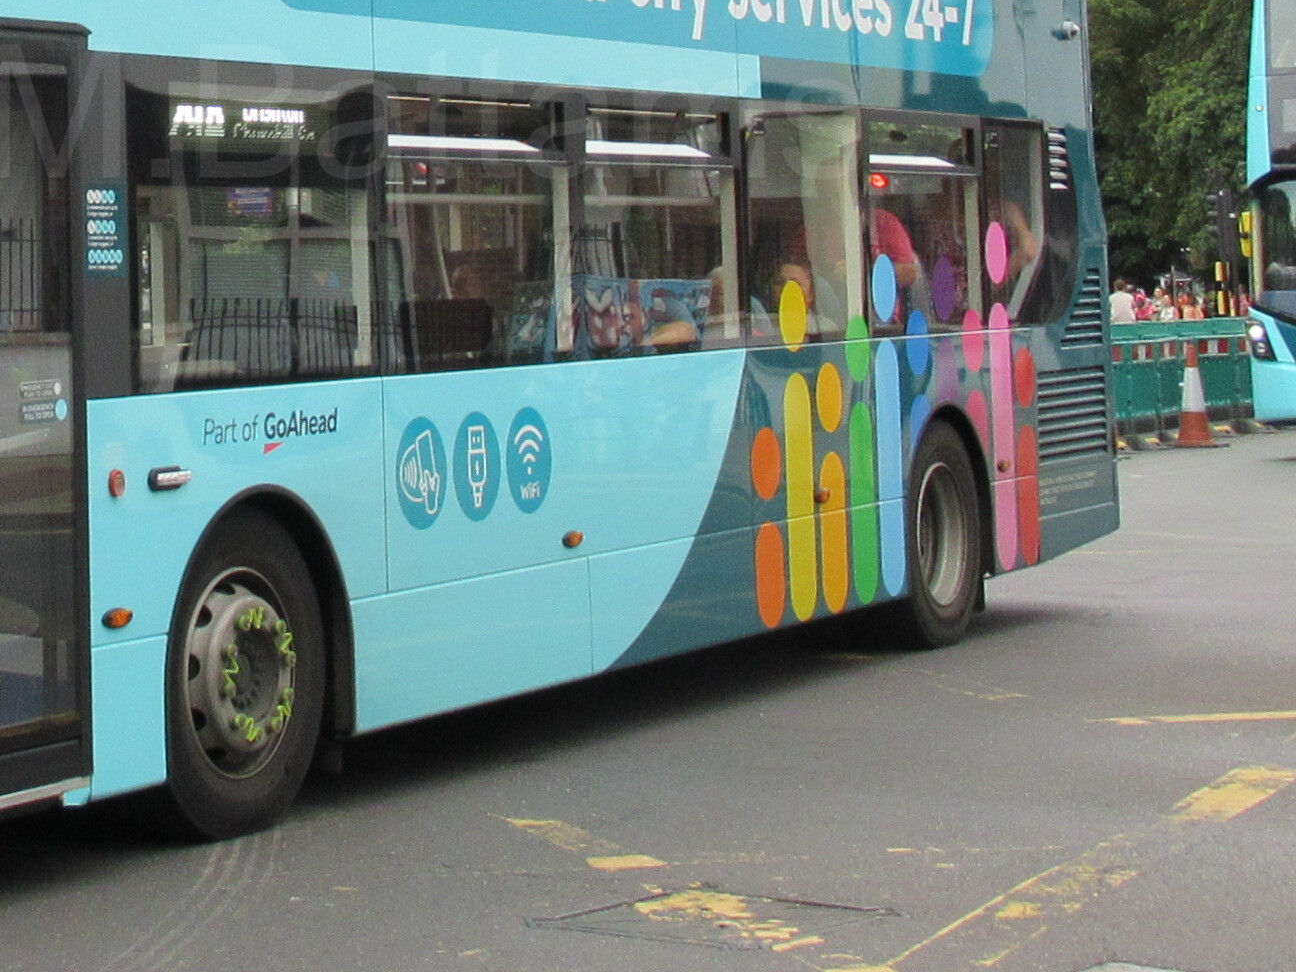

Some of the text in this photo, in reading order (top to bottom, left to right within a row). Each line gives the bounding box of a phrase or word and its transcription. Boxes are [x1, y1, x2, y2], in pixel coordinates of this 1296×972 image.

[202, 406, 339, 446] Part of GoAhead
